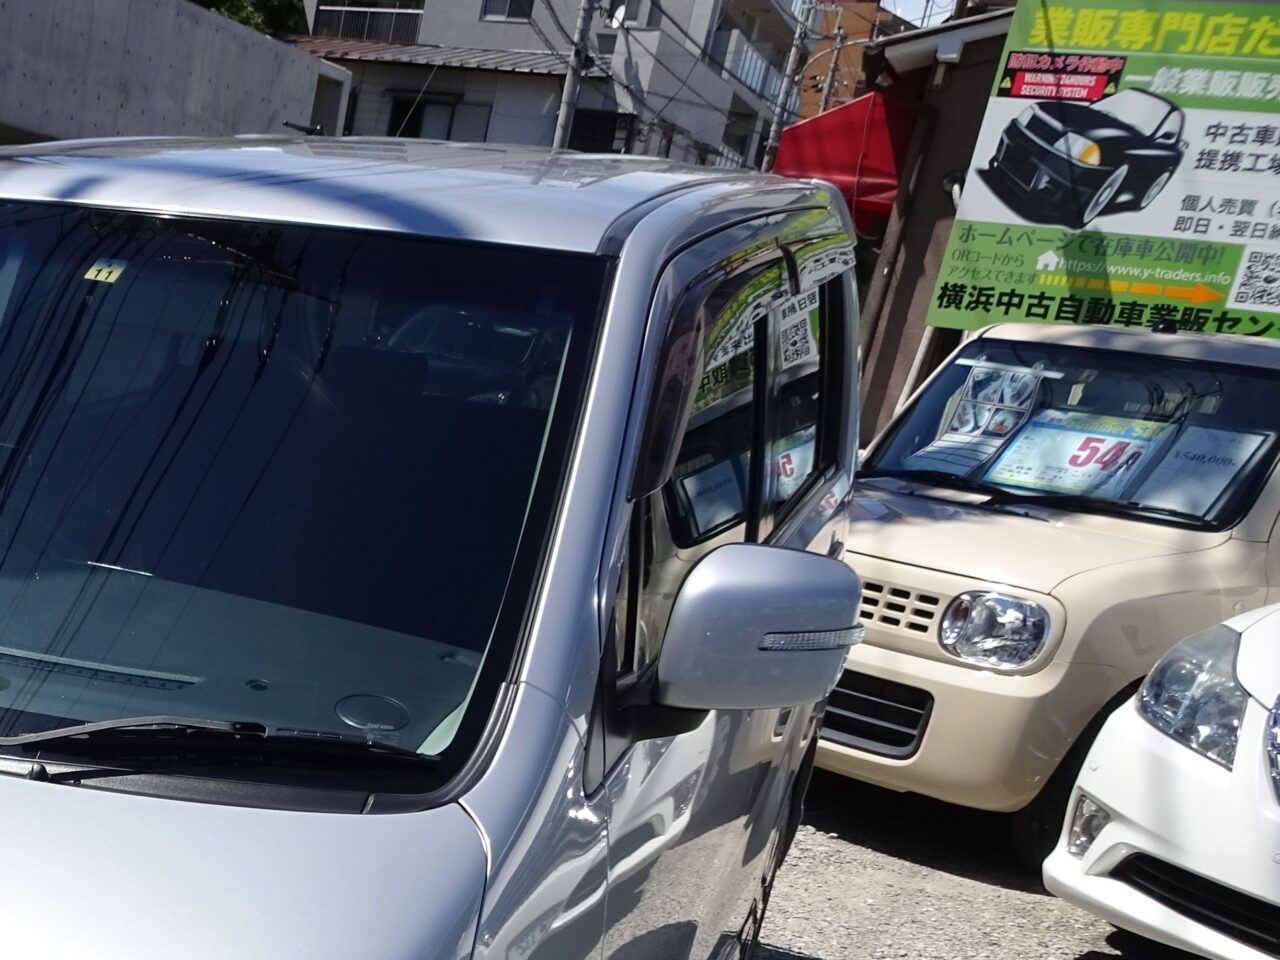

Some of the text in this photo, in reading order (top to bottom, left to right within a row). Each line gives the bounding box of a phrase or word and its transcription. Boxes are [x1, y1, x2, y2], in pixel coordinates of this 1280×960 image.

[1020, 85, 1057, 97] SECURITY
[1205, 121, 1280, 146] 中古車
[94, 268, 114, 281] 11
[1058, 257, 1232, 285] https://www.y-traders.info
[937, 281, 1280, 337] 横浜中古自動車業販セン
